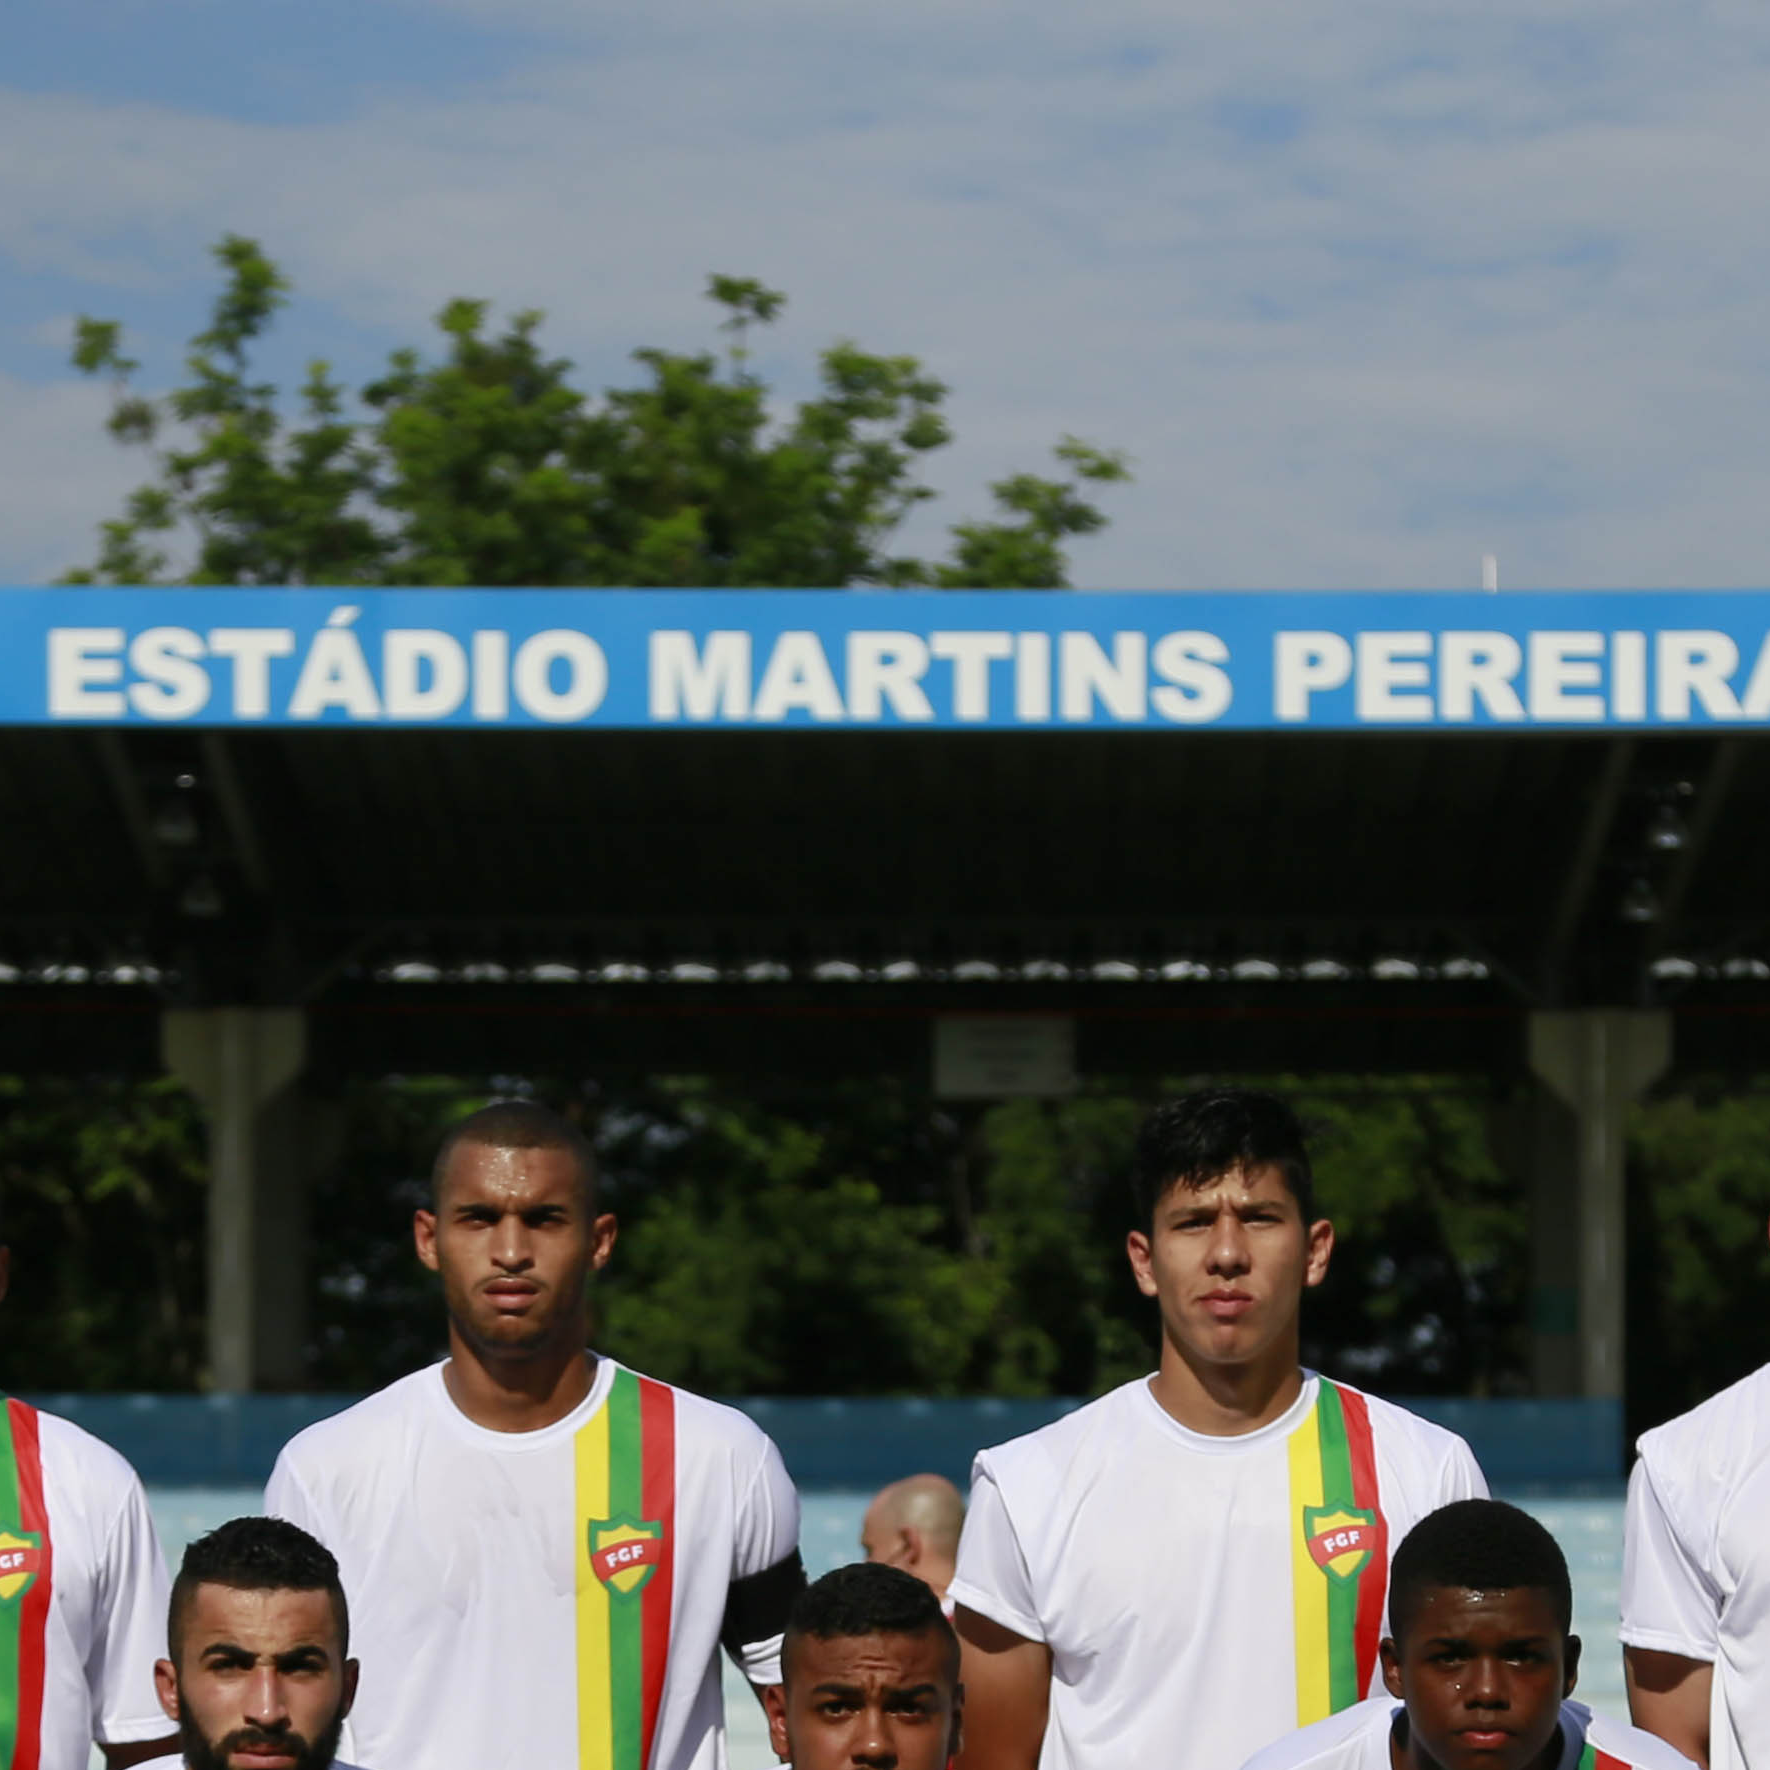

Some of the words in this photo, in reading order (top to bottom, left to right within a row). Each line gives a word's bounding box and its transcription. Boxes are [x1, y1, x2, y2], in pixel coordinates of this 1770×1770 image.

[48, 606, 607, 721] ESTÁDIO
[649, 630, 1232, 722] MARTINS
[1324, 1529, 1360, 1553] FGF
[604, 1544, 644, 1568] FGF
